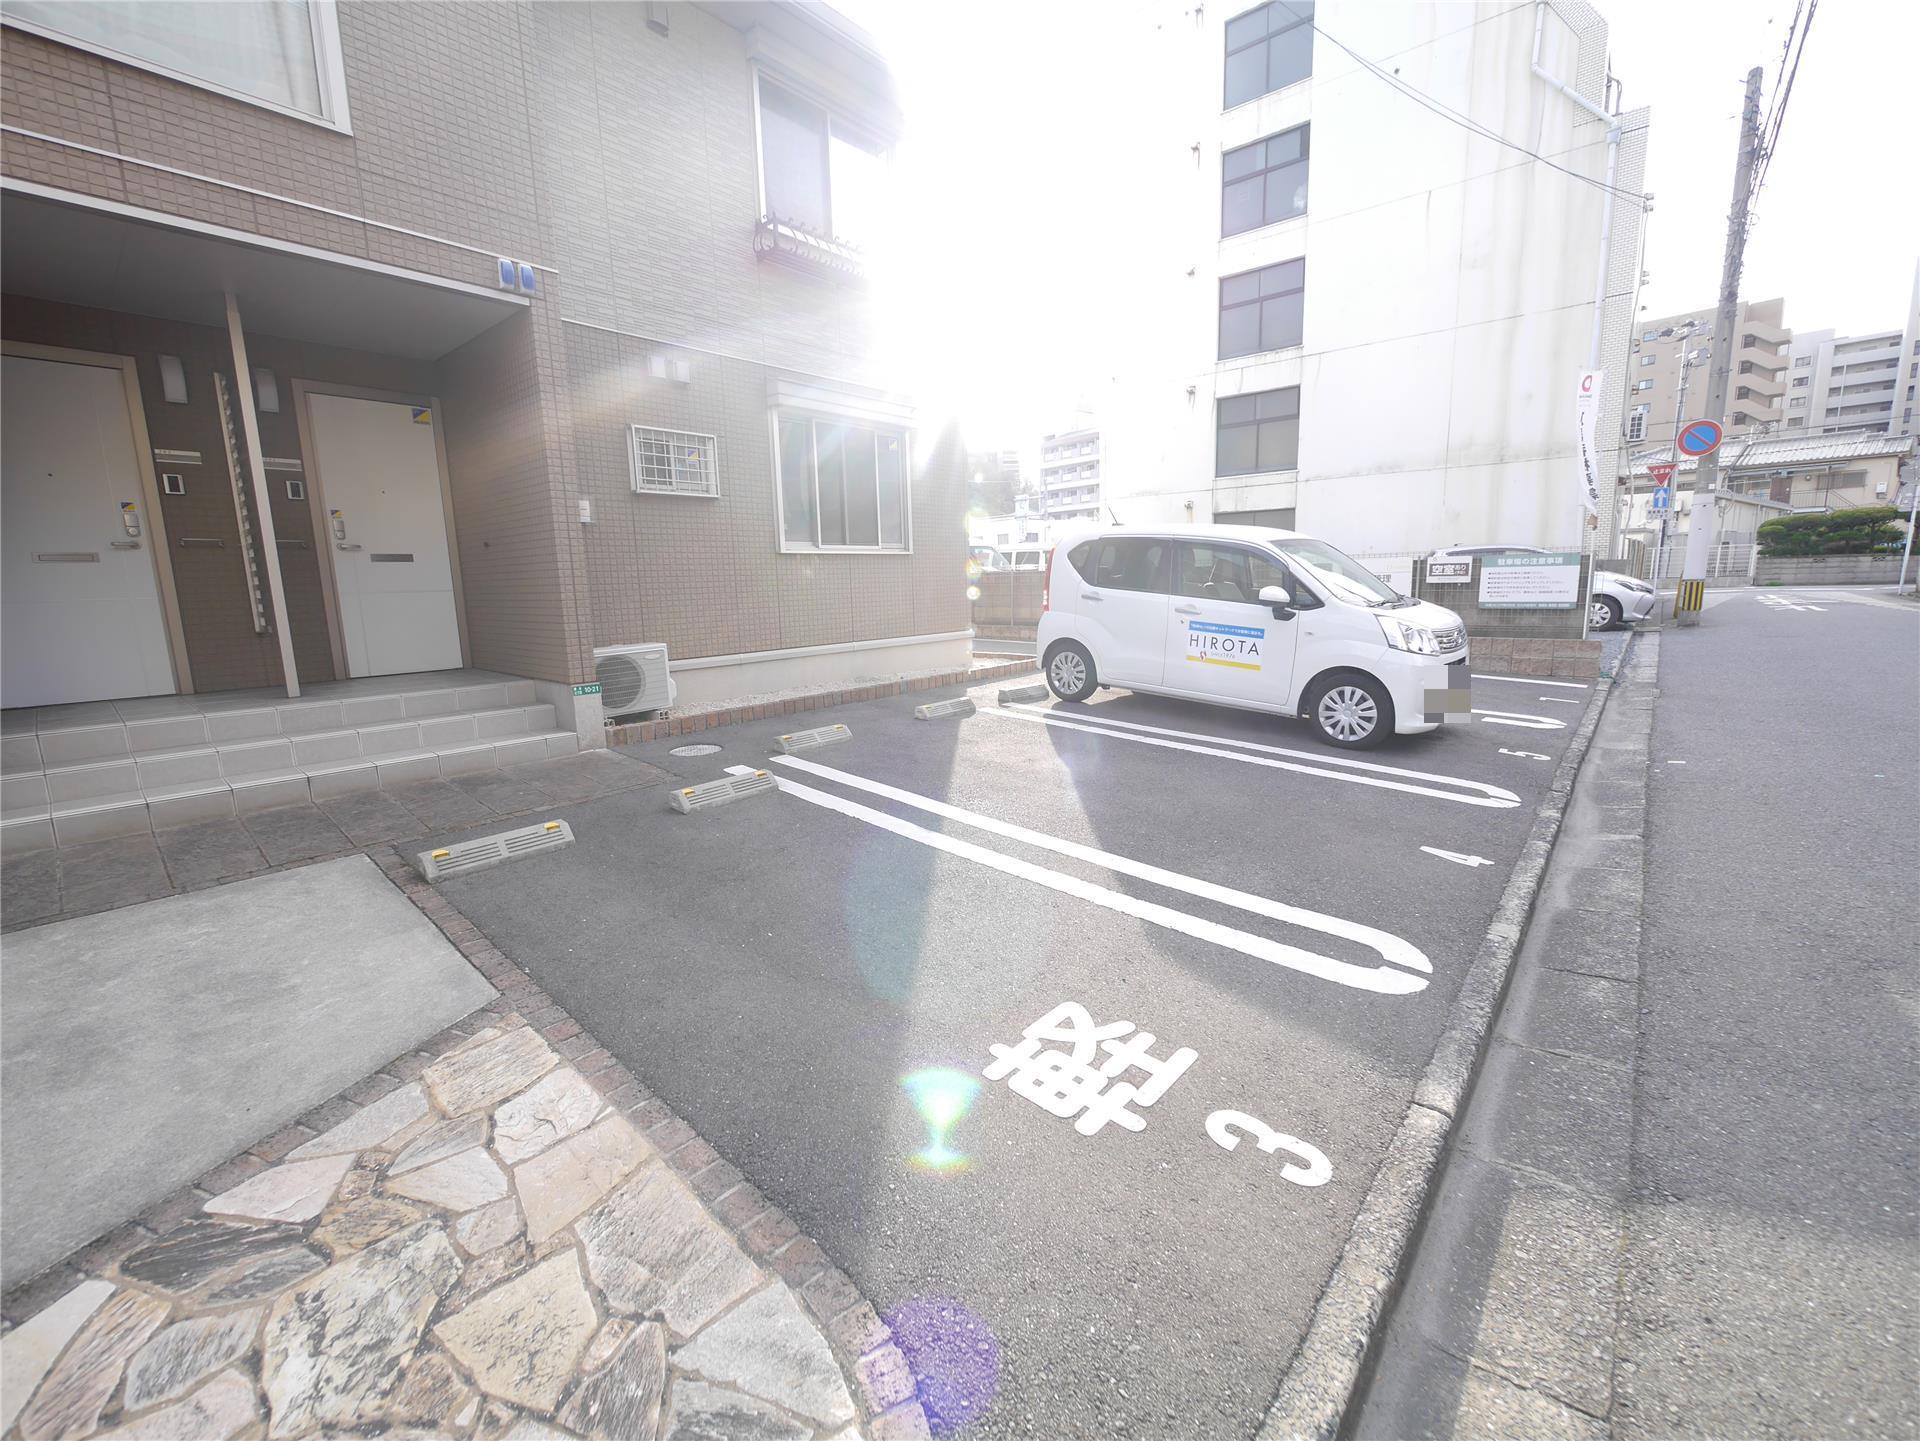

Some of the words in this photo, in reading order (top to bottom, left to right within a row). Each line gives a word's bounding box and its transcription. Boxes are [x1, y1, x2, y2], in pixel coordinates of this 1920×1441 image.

[1190, 634, 1259, 655] HIROTA
[1498, 748, 1551, 761] 5
[1419, 845, 1495, 867] 4
[981, 1001, 1199, 1136] 軽
[1205, 1109, 1333, 1187] 3
